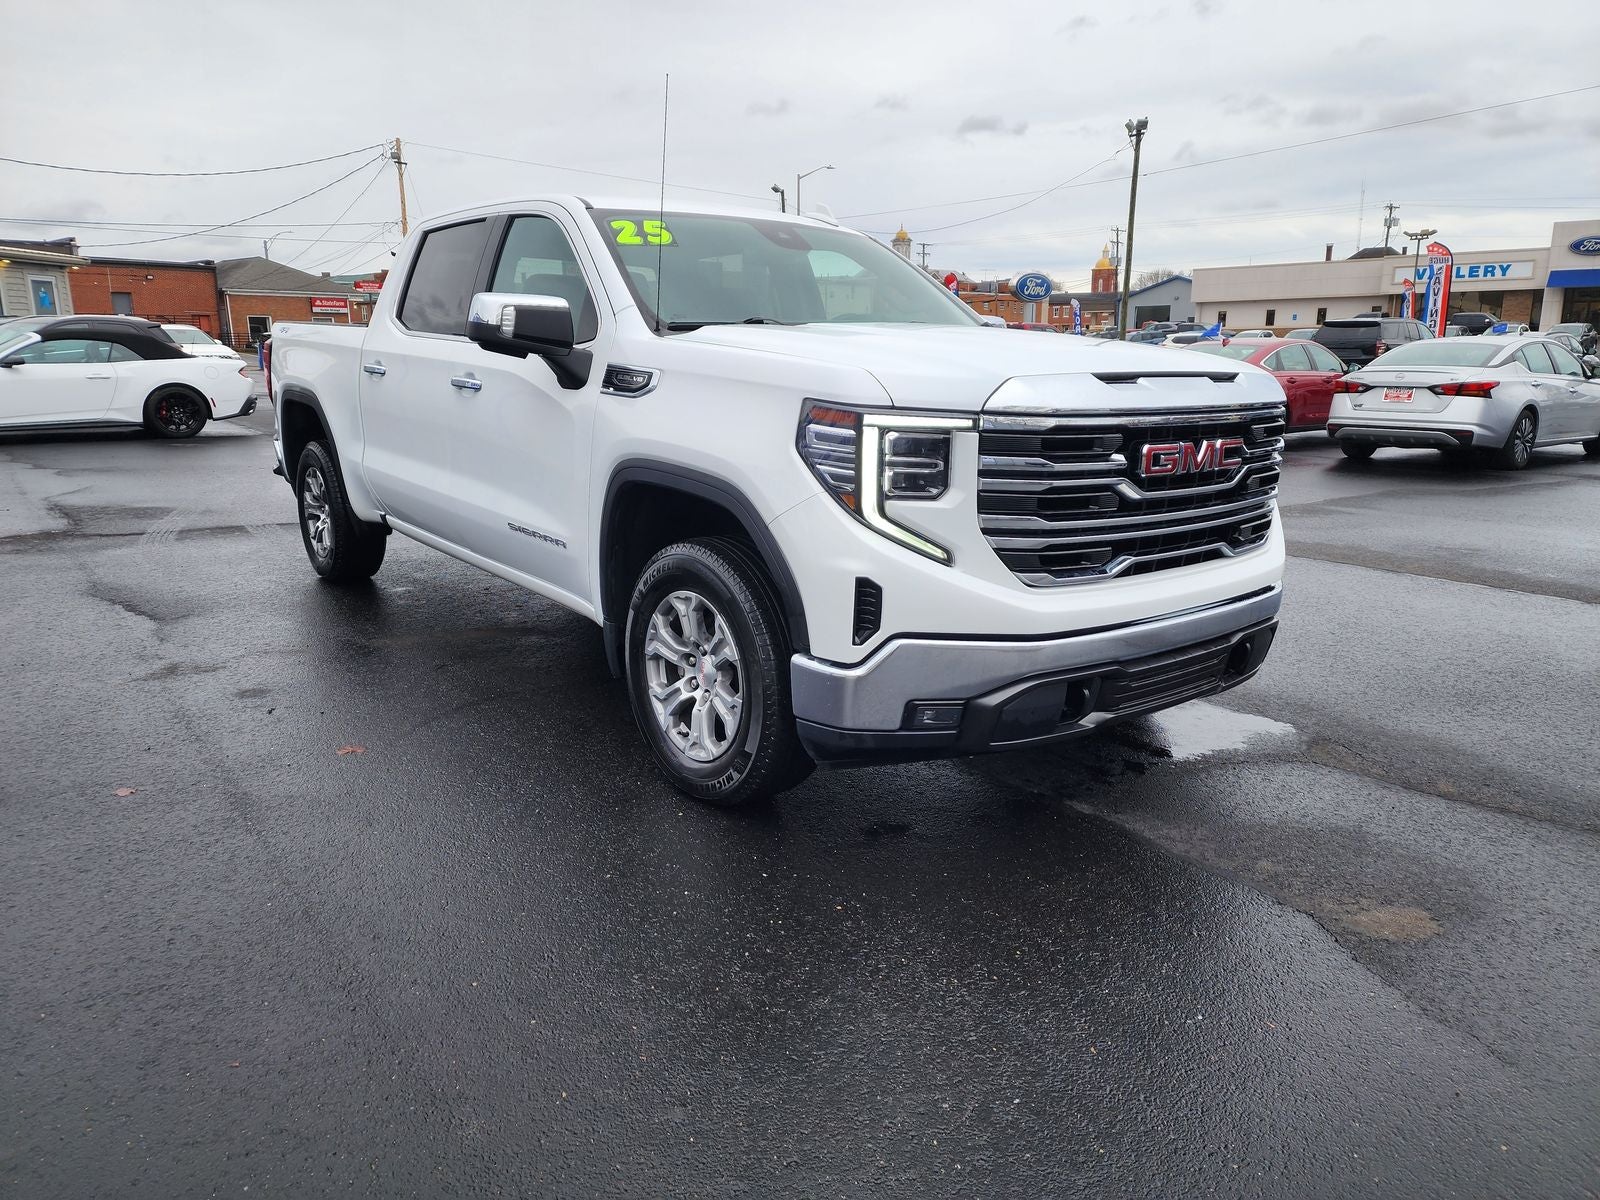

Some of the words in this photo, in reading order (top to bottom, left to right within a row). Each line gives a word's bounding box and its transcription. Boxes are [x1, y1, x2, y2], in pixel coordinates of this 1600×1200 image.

[609, 220, 672, 245] 25
[1580, 239, 1600, 251] For
[1416, 264, 1512, 280] VLERY
[1024, 277, 1048, 296] Ford
[1142, 439, 1244, 477] GMC
[507, 522, 567, 549] SIERRA
